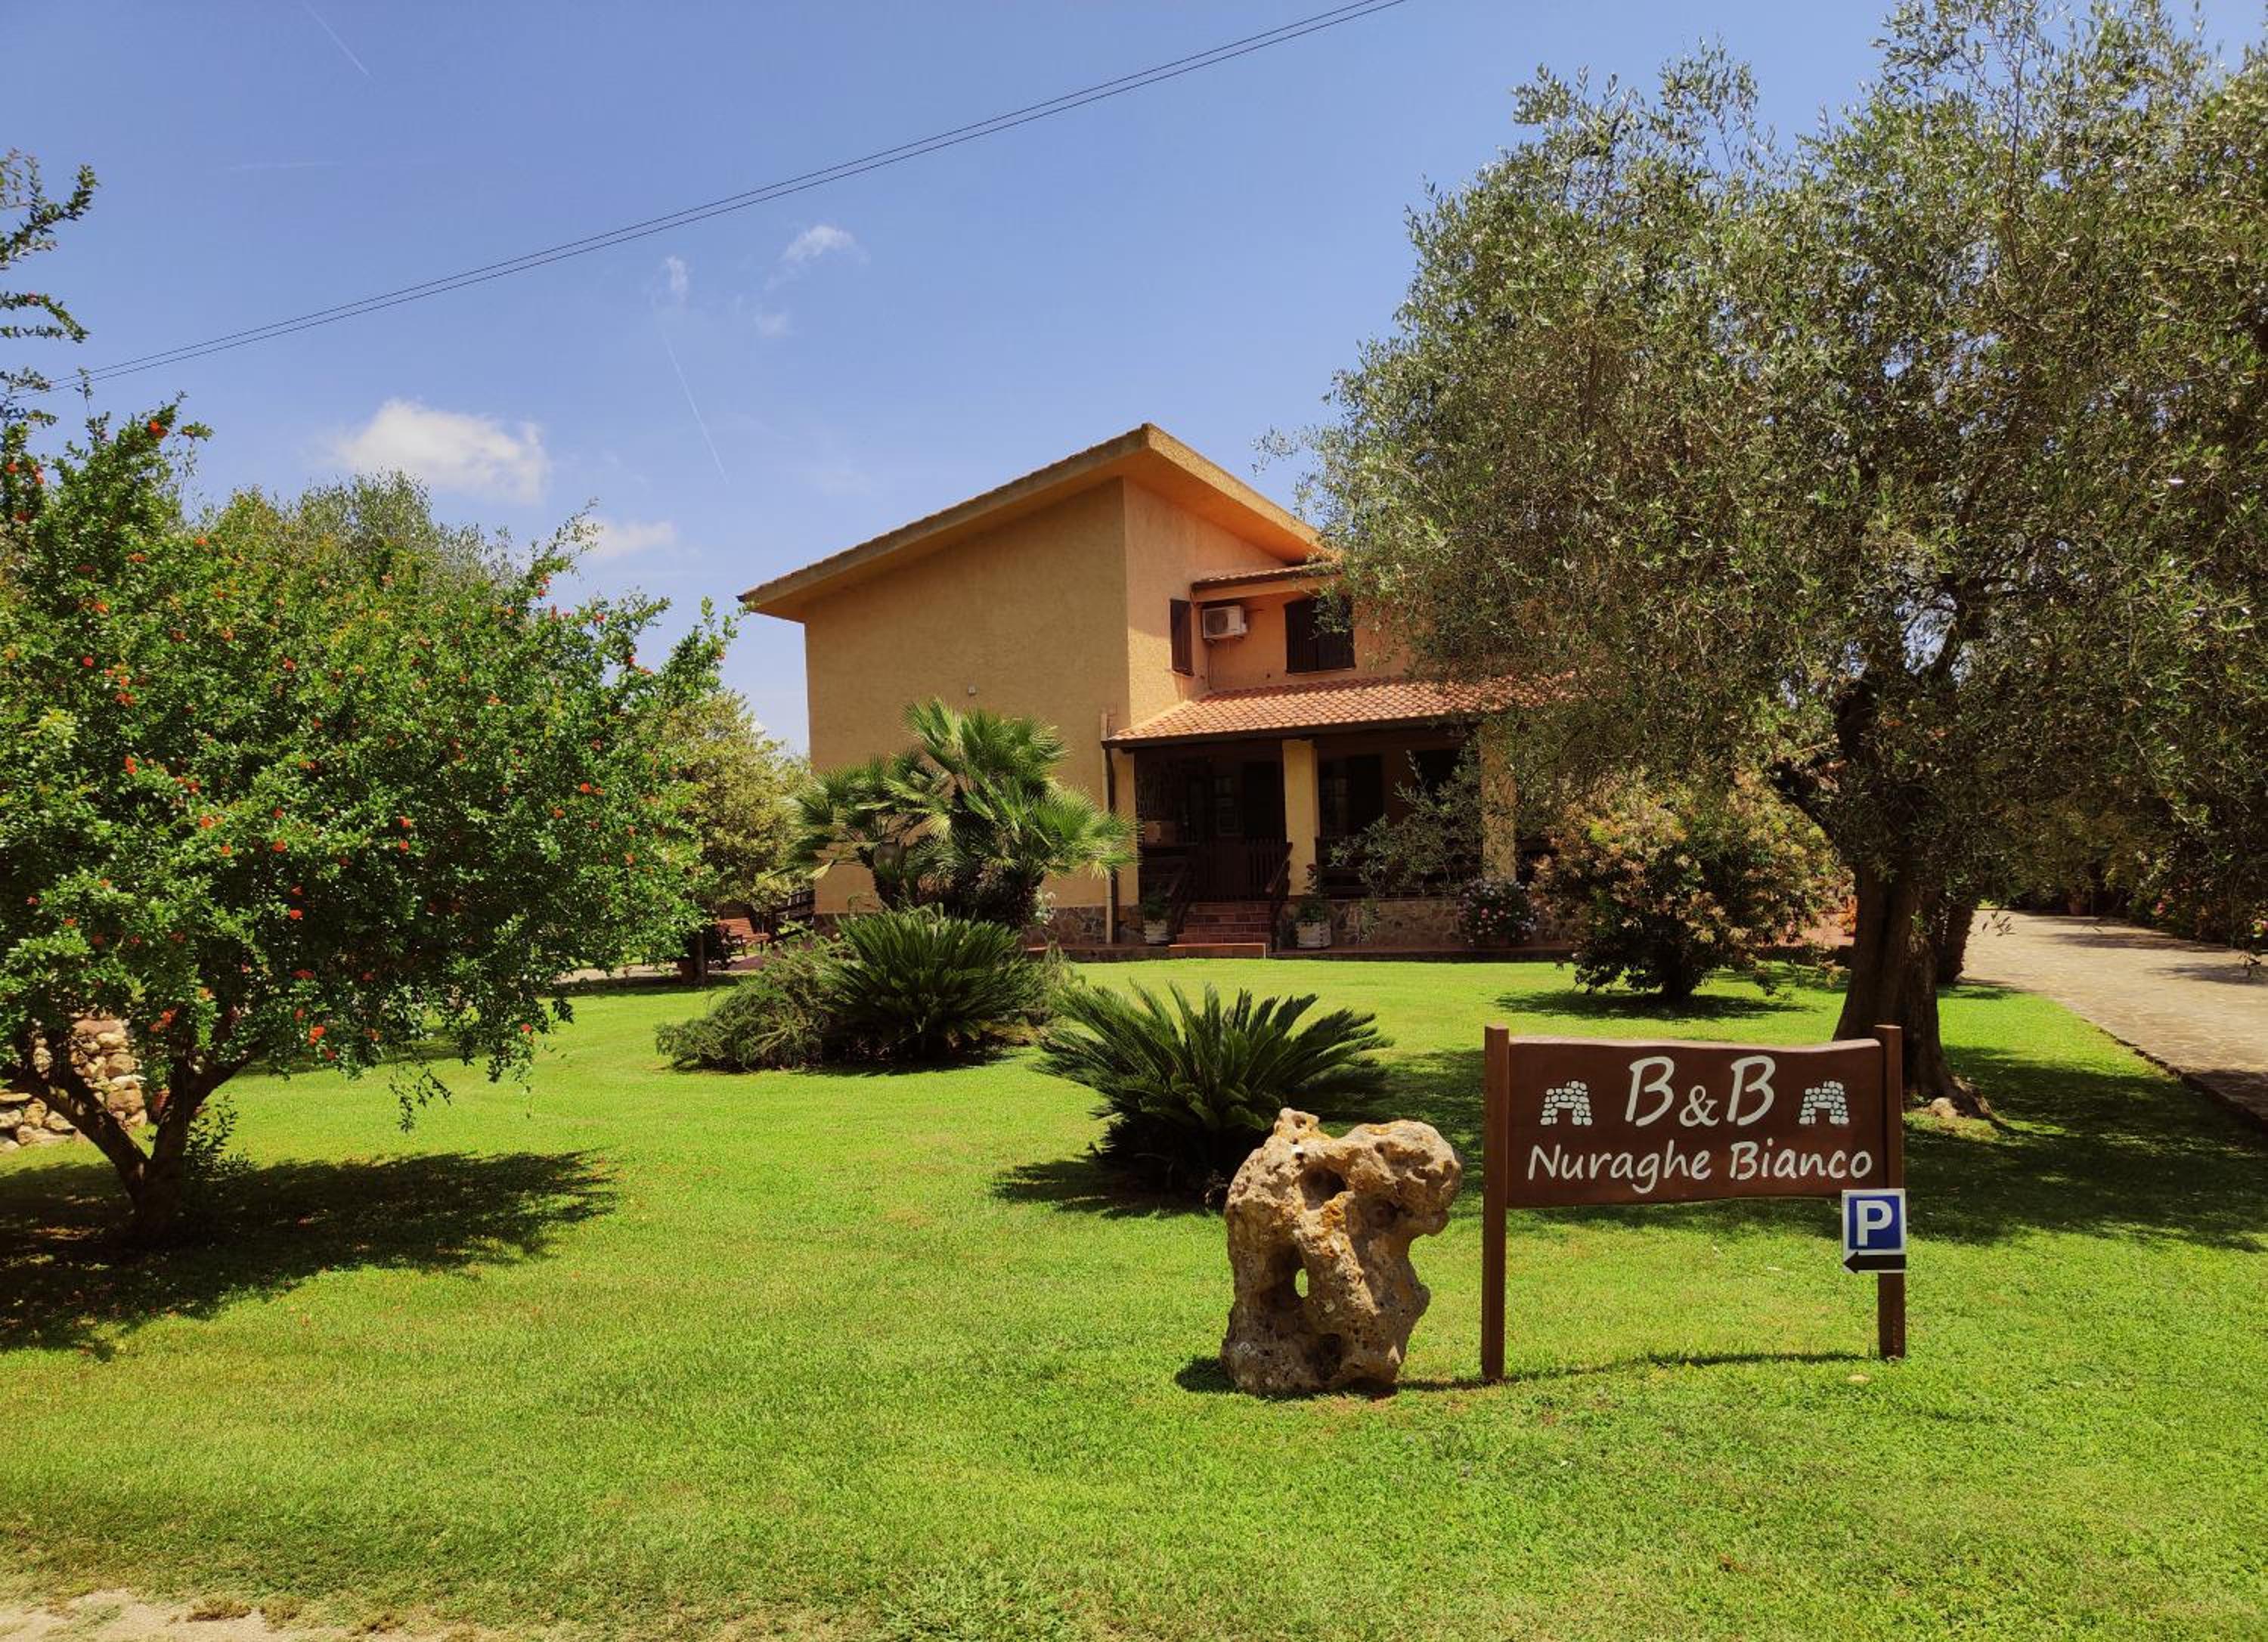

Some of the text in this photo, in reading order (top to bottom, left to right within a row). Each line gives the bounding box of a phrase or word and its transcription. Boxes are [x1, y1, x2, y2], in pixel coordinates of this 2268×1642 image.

[1625, 1055, 1777, 1128] B&B
[1527, 1137, 1873, 1194] Nuraghe Bianco
[1856, 1201, 1892, 1246] P
